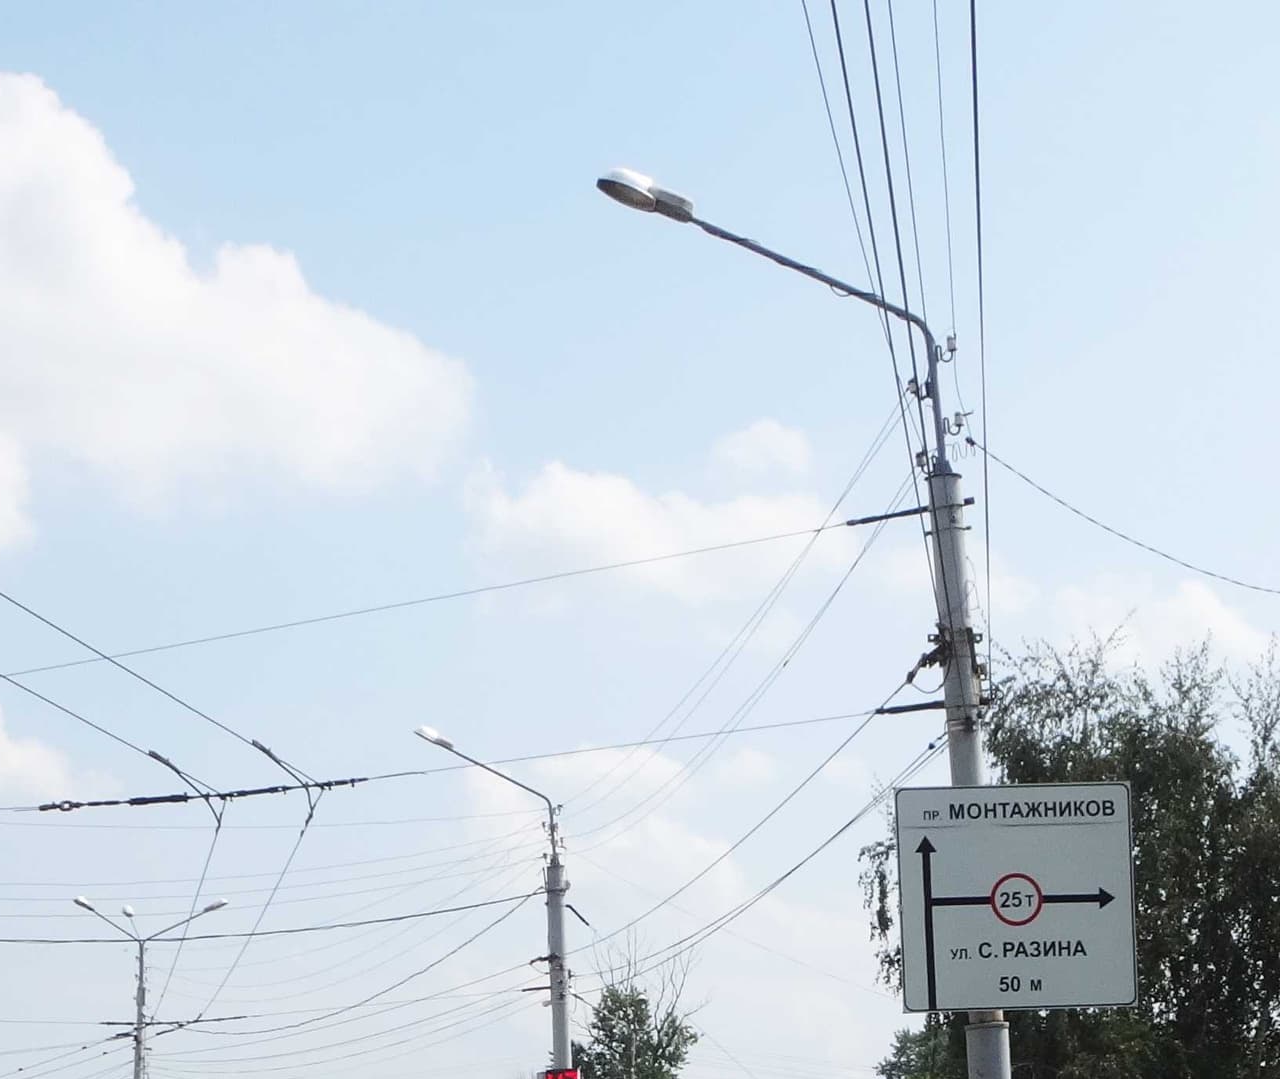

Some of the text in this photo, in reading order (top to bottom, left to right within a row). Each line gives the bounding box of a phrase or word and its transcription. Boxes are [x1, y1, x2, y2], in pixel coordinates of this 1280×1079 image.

[948, 799, 1116, 820] МОНТАЖНИКОВ
[1003, 940, 1088, 959] РАЗИНА
[999, 975, 1021, 993] 50
